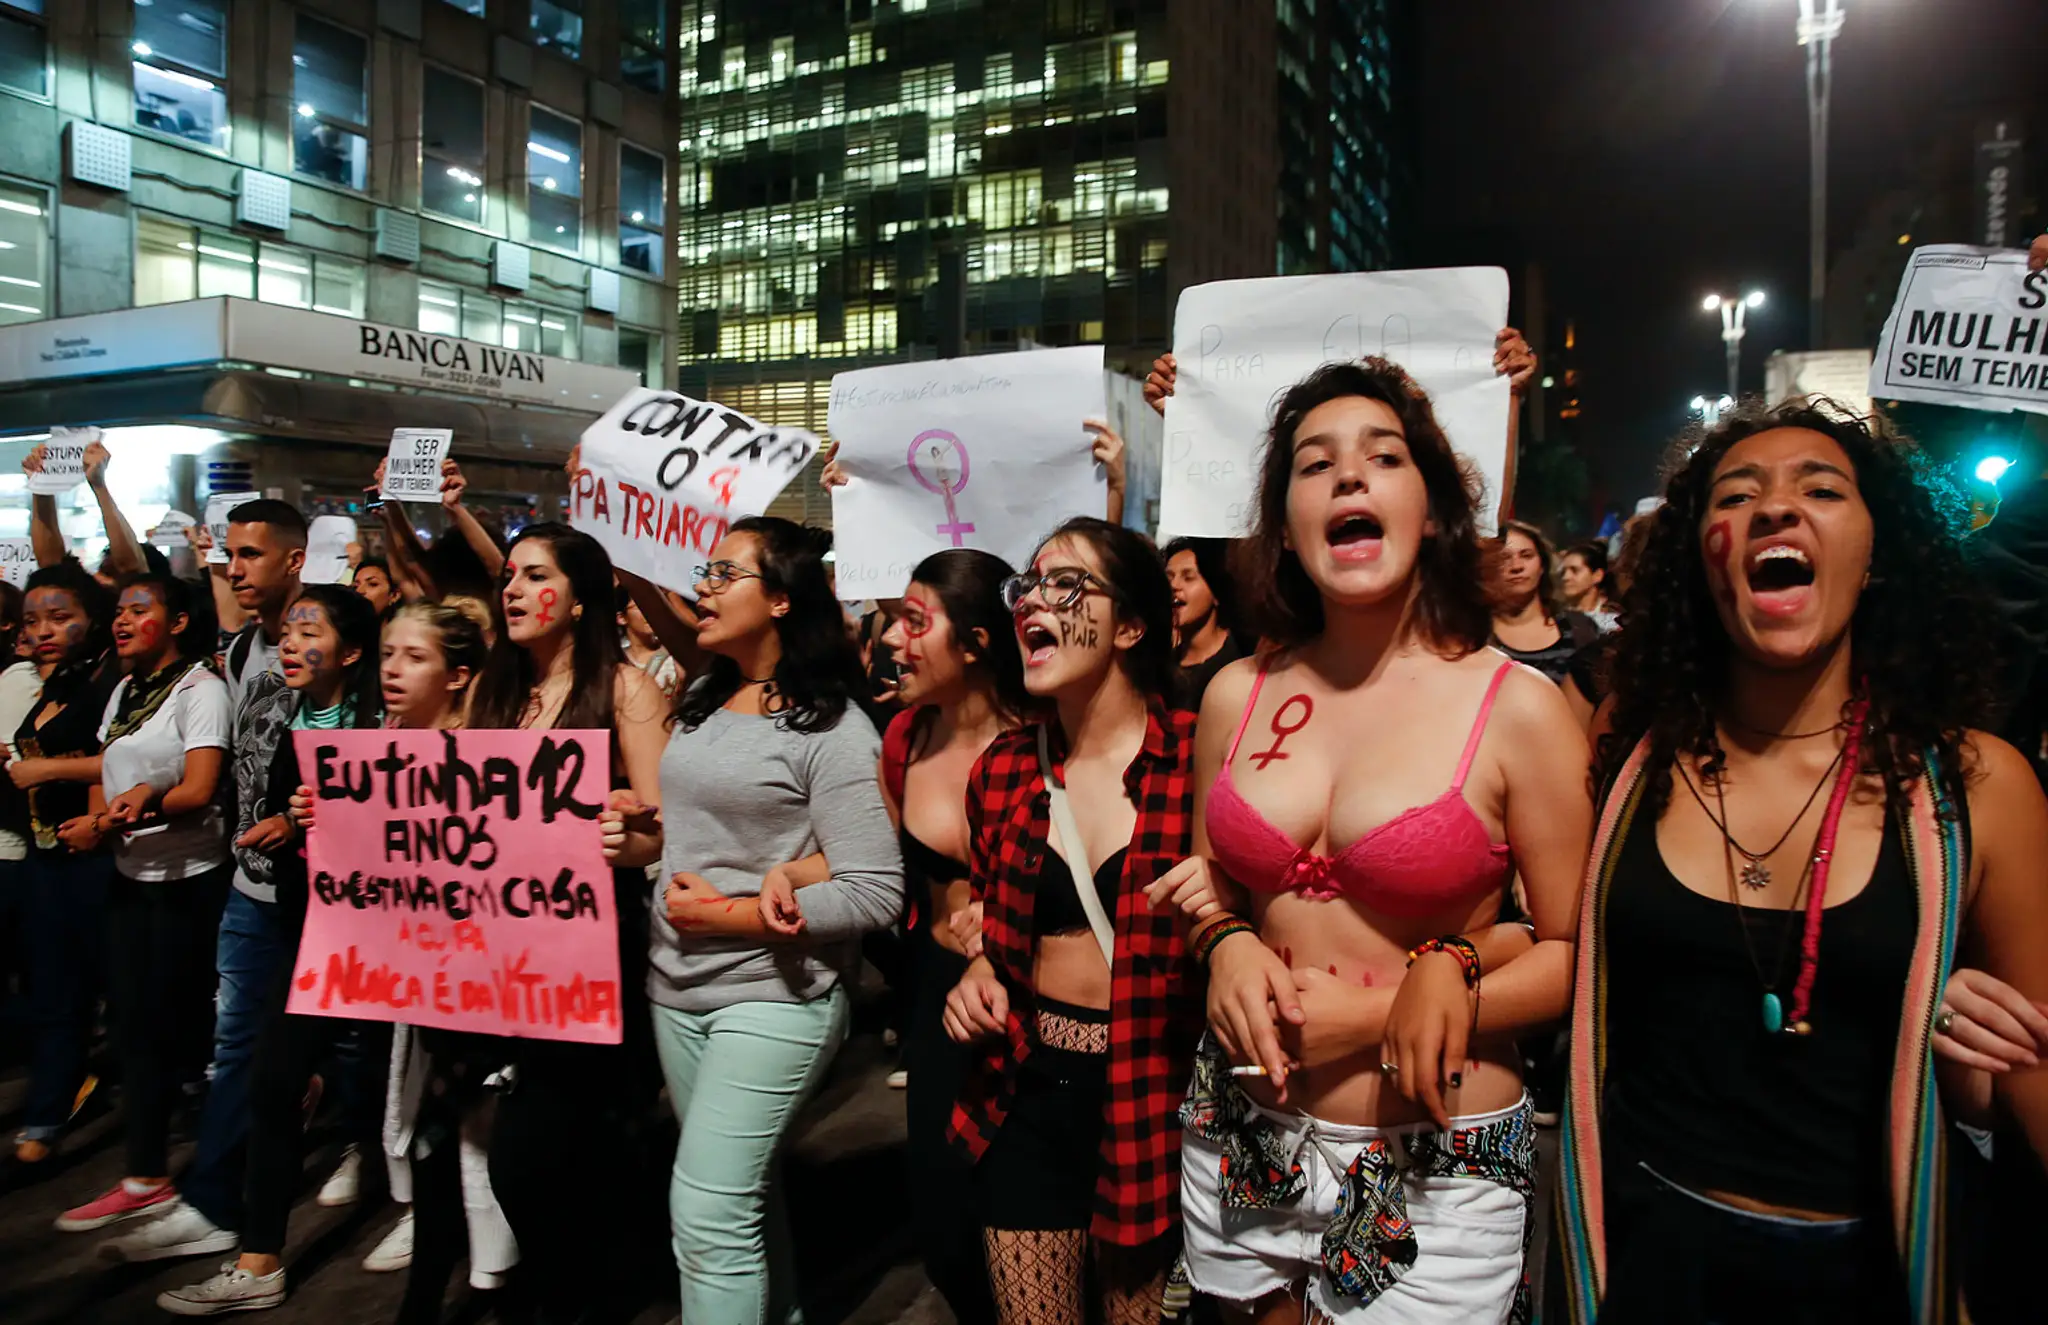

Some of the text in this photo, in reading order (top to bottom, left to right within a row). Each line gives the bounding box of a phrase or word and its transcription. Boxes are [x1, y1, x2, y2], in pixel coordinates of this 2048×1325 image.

[359, 325, 544, 383] BANCA IVAN
[1900, 352, 1963, 382] SEM
[42, 445, 83, 460] ESTUPR
[415, 438, 439, 456] SER
[621, 396, 812, 471] CONTRA
[390, 458, 436, 476] MULHER
[657, 447, 699, 490] O
[1060, 621, 1098, 650] PWR
[526, 735, 604, 823] 12
[384, 815, 497, 870] ANOS
[442, 880, 498, 920] EM
[501, 867, 599, 921] CASA
[434, 954, 455, 1015] É
